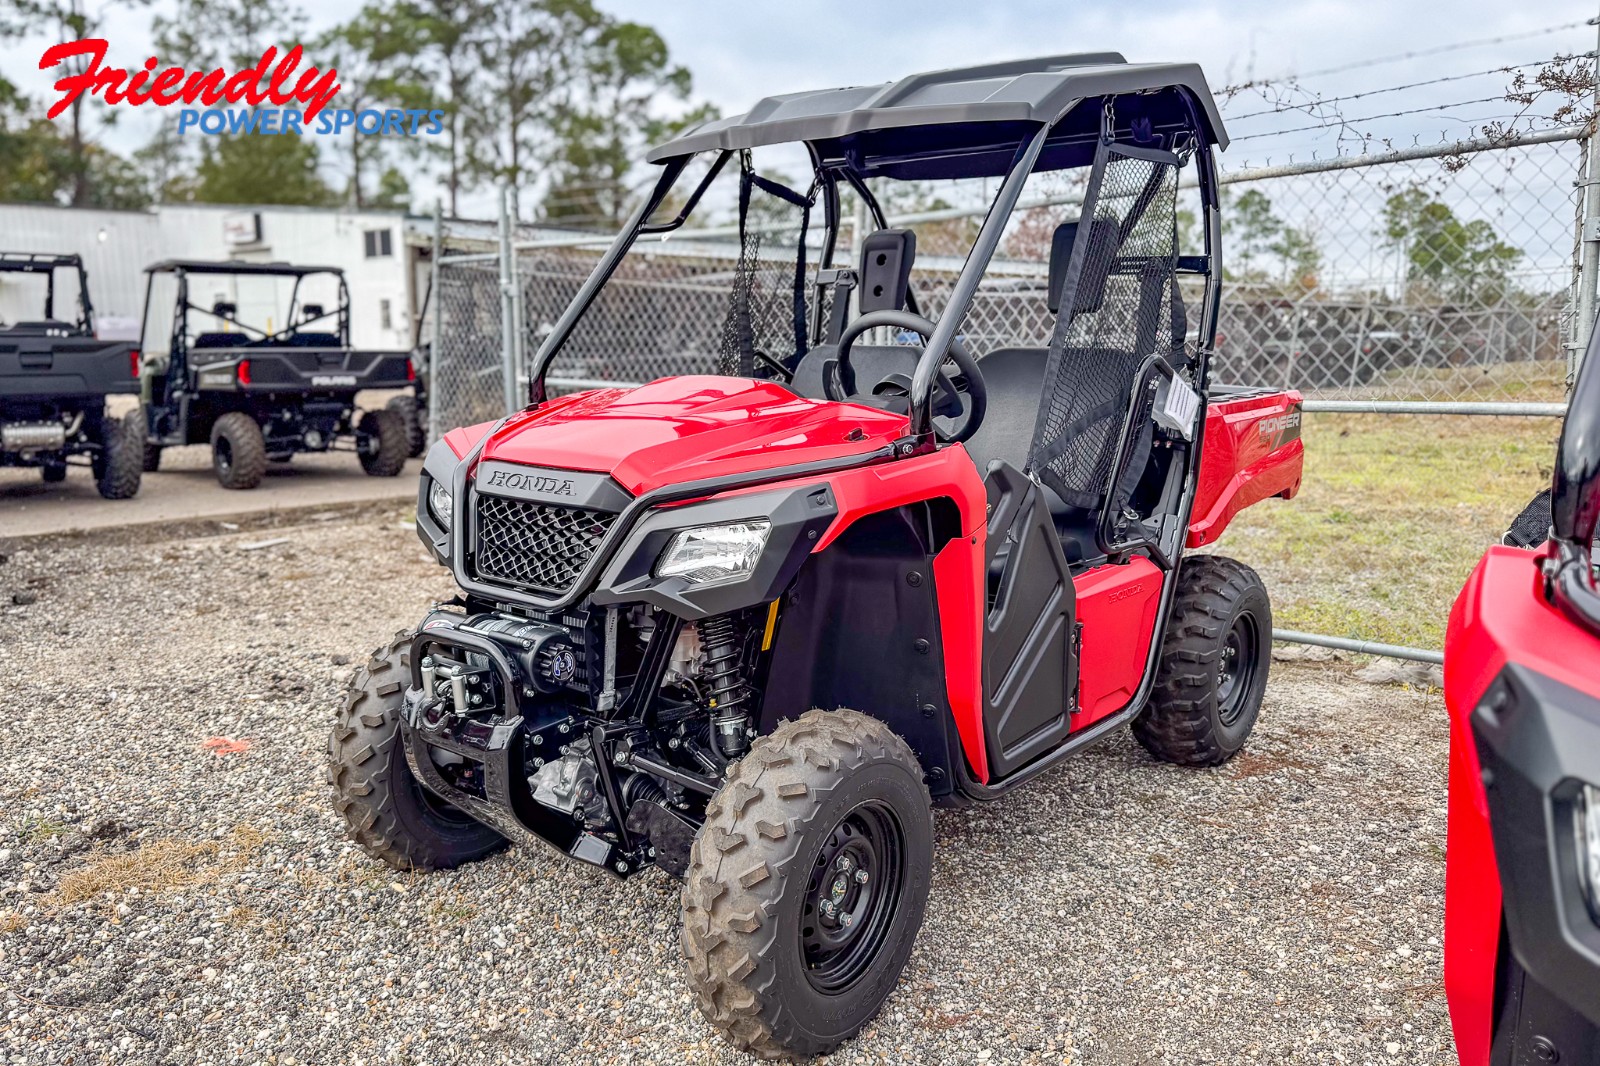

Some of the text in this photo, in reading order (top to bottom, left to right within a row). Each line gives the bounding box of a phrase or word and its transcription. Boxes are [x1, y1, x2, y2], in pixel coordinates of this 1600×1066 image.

[1258, 412, 1300, 436] PIONEER
[487, 470, 577, 496] HONDA
[1108, 582, 1144, 604] HONDA
